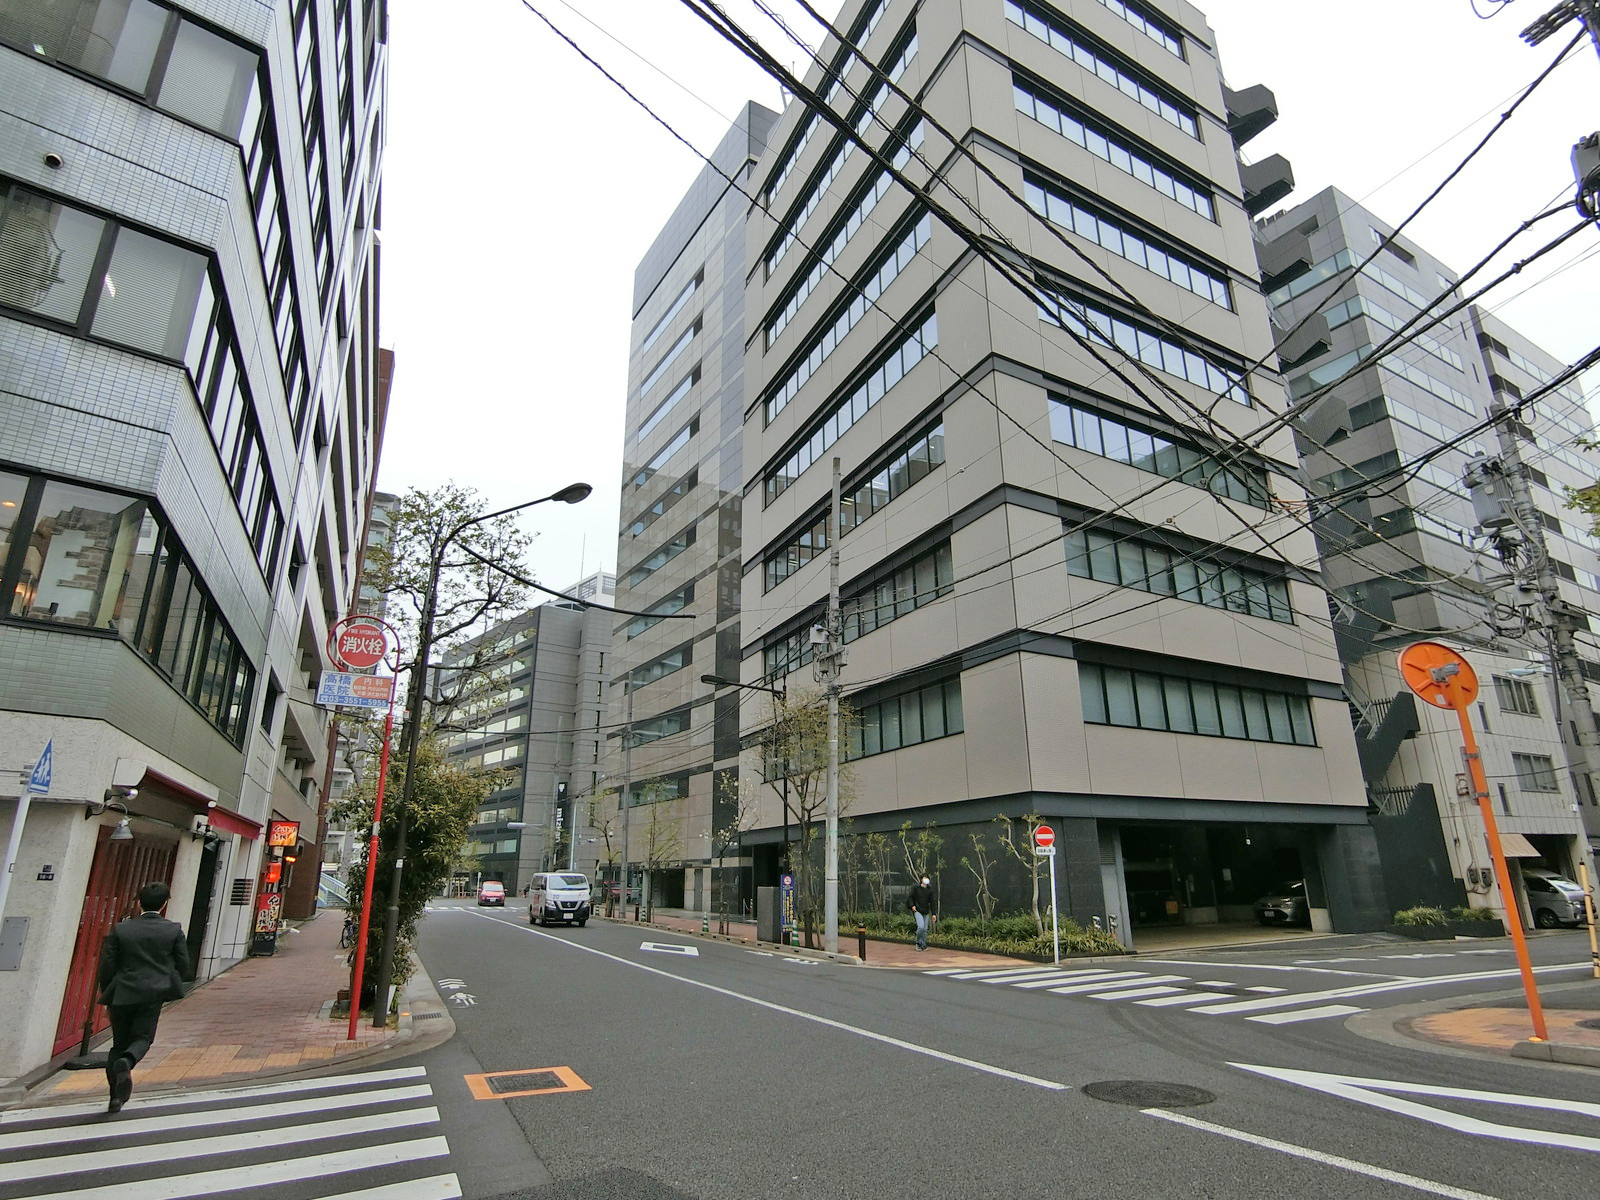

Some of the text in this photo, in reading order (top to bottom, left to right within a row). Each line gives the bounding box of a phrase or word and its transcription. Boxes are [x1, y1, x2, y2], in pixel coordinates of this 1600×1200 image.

[341, 635, 384, 655] 消火栓
[324, 674, 352, 686] 高橋
[364, 677, 384, 686] 内科
[323, 684, 350, 696] 医院
[329, 696, 386, 706] 03-3551-5955
[267, 894, 280, 929] やきとり
